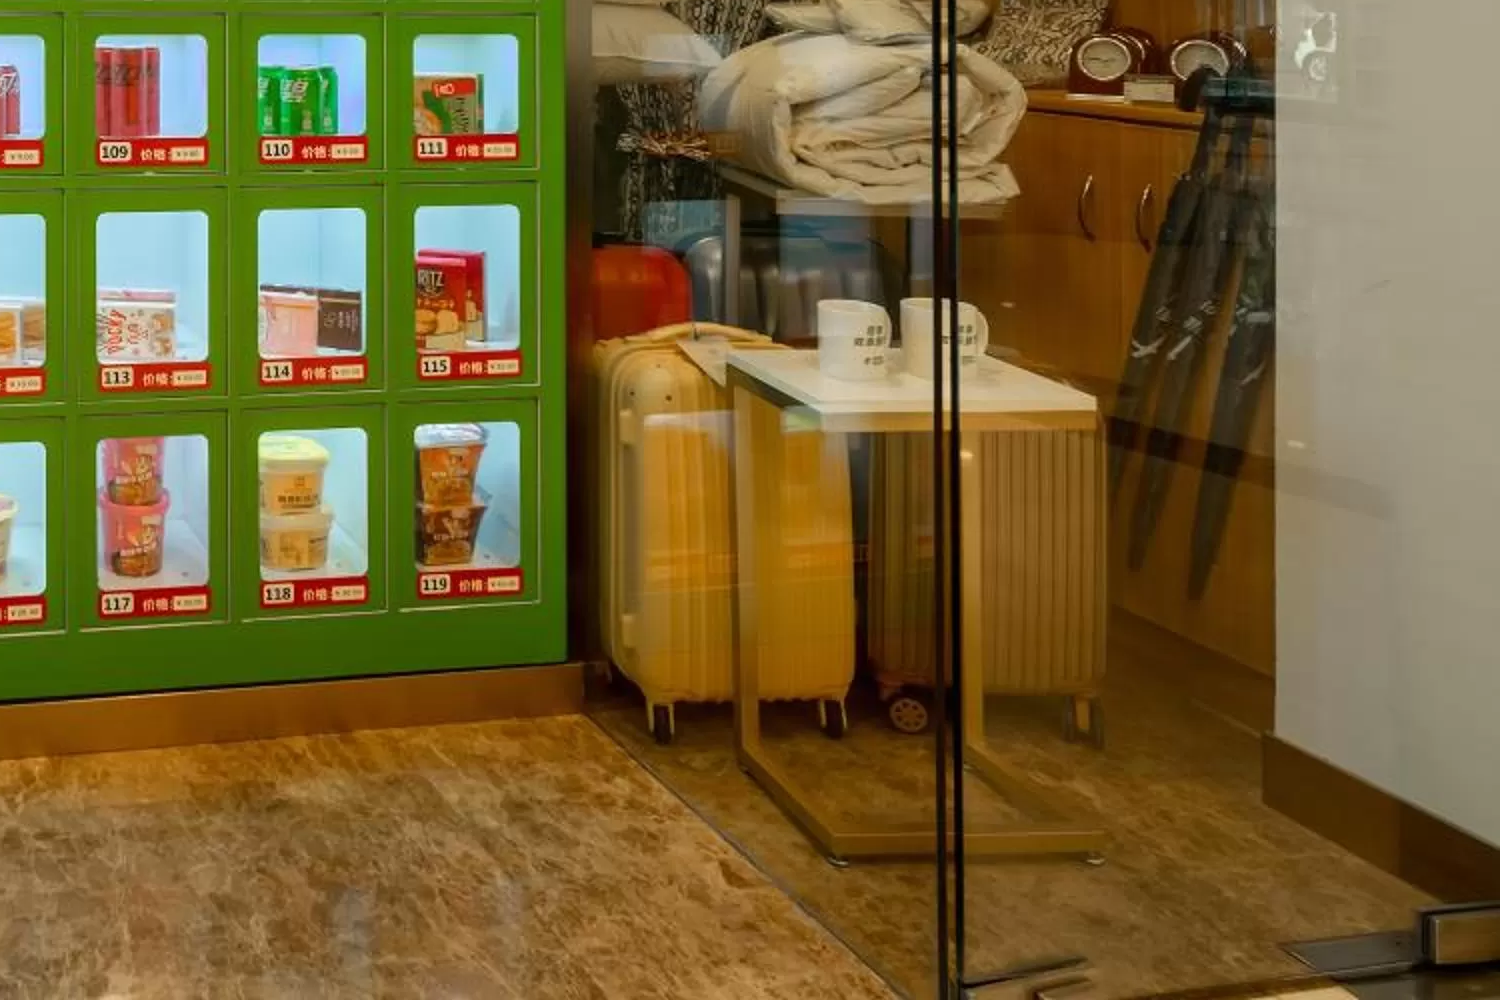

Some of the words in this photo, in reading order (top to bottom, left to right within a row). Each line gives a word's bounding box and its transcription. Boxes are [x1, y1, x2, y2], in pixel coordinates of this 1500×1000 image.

[102, 146, 128, 159] 109
[265, 144, 290, 156] 110
[420, 142, 443, 154] 111
[418, 269, 444, 287] RITZ
[264, 365, 290, 378] 114
[423, 360, 447, 372] 115
[105, 371, 130, 384] 113
[423, 579, 446, 591] 119
[266, 588, 291, 600] 118
[104, 598, 130, 611] 117
